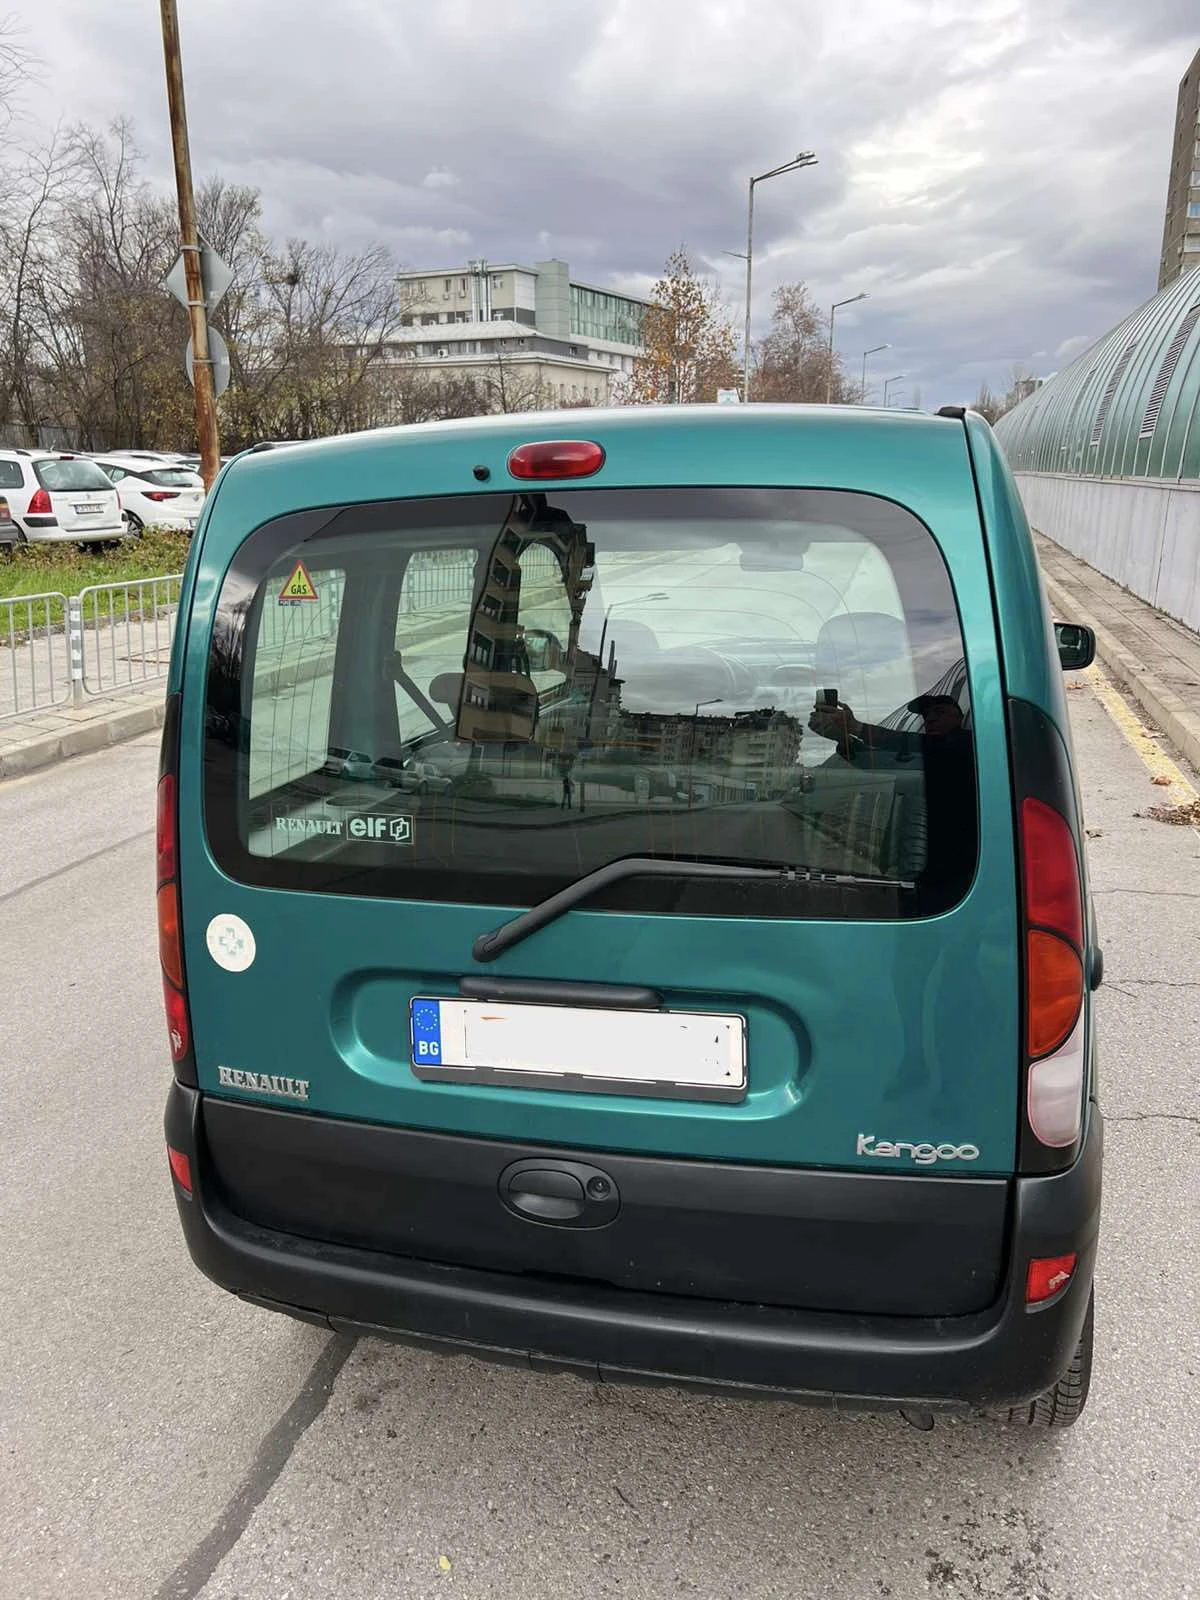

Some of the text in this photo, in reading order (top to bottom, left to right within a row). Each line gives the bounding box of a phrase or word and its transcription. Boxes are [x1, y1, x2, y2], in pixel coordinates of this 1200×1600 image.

[291, 584, 307, 594] GAS
[275, 817, 387, 838] RENAULT elf
[418, 1040, 440, 1056] BG
[218, 1065, 309, 1099] RENAULT
[856, 1133, 980, 1165] Kangoo
